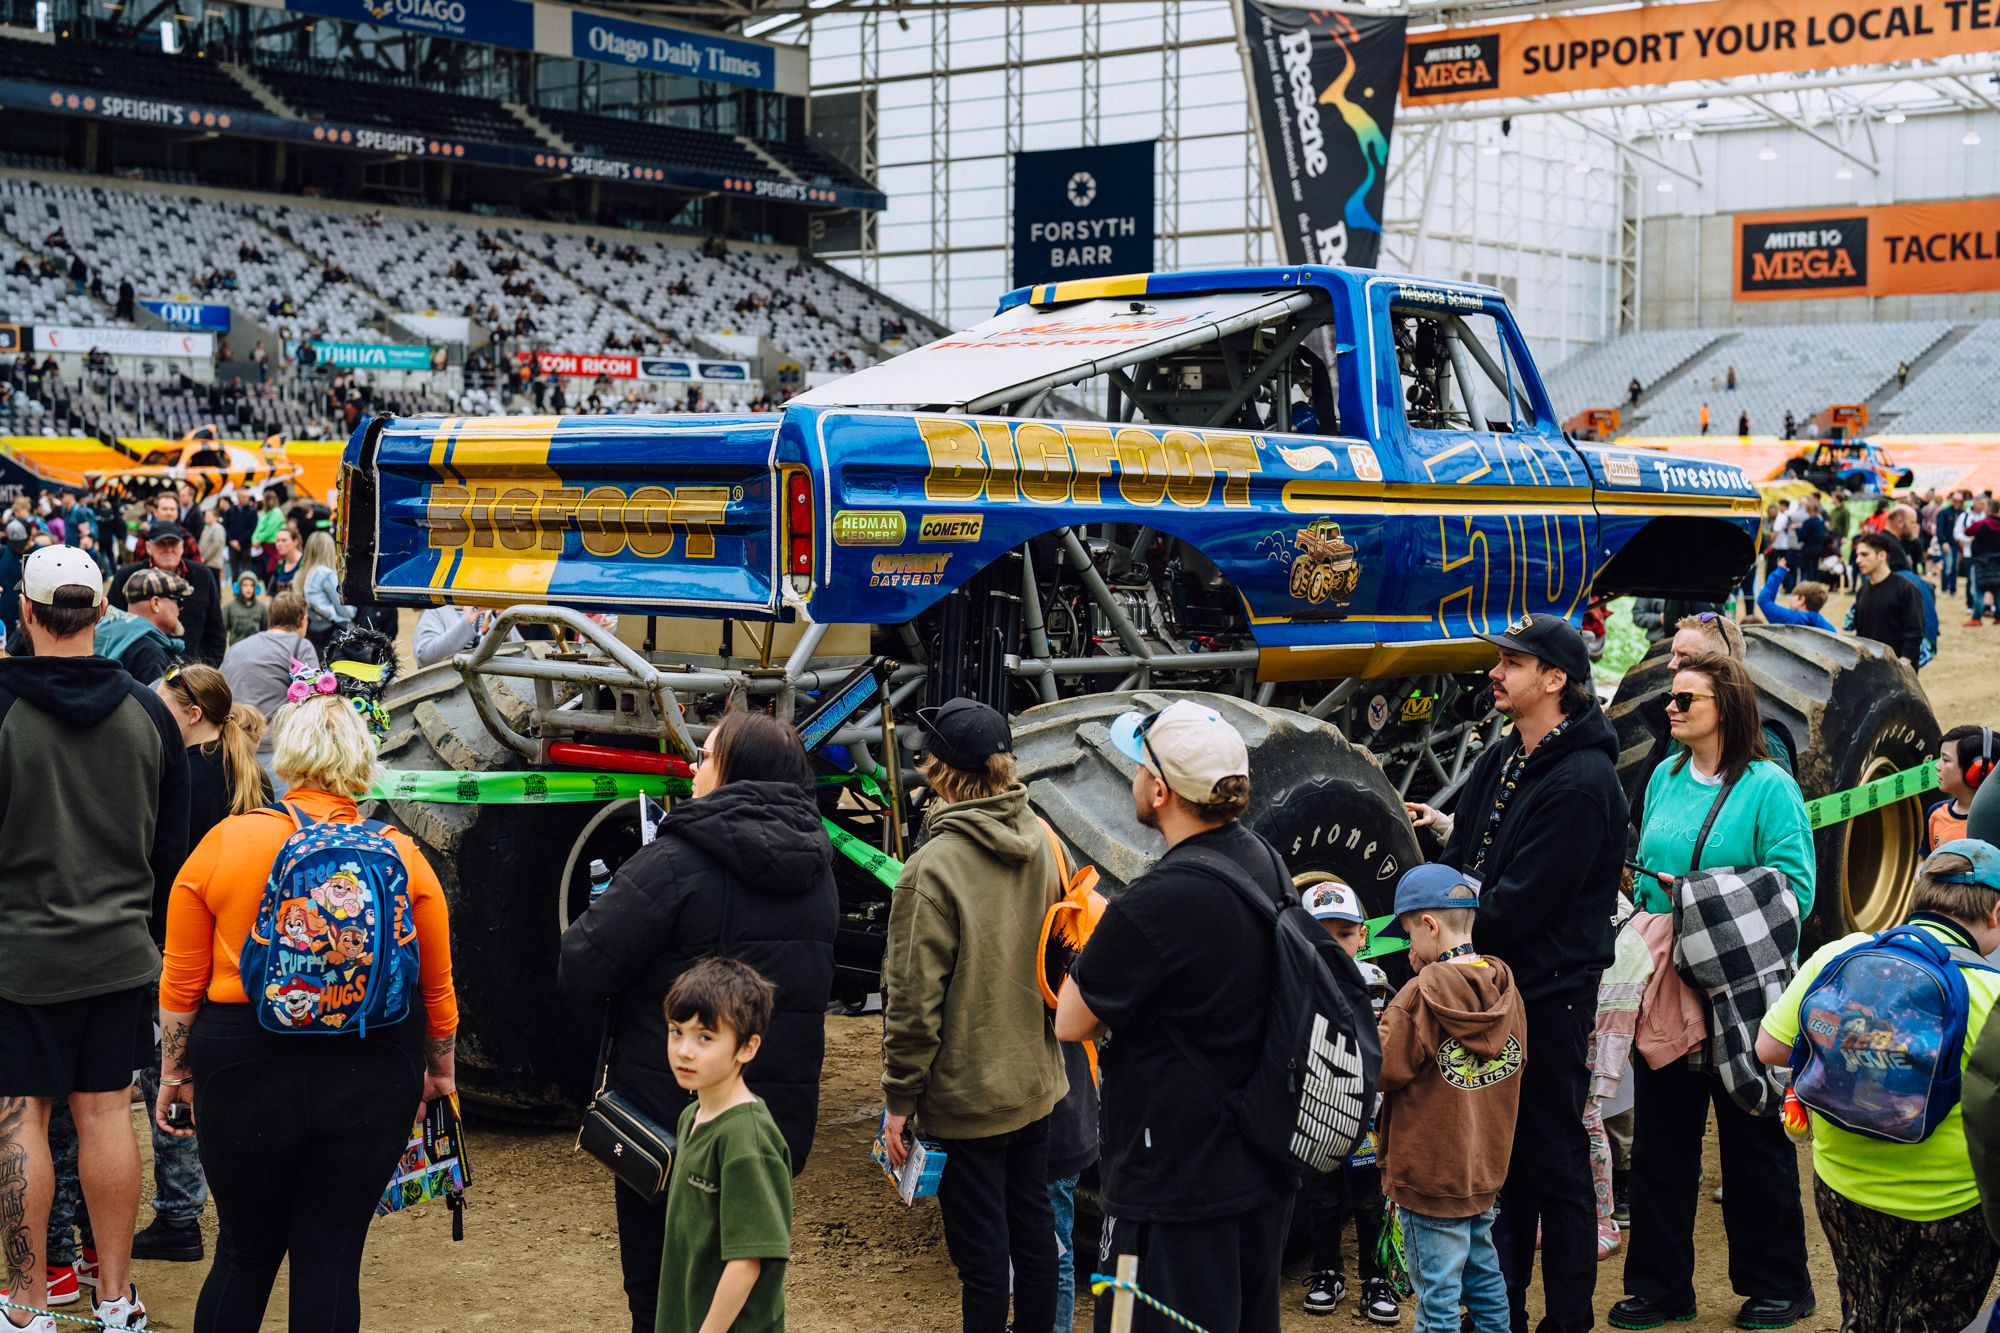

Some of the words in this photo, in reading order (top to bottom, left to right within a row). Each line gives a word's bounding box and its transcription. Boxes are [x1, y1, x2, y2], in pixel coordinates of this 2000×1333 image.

[397, 0, 465, 23] OTAGO
[1523, 31, 1684, 75] SUPPORT
[1694, 19, 1796, 57] YOUR
[1807, 4, 1933, 47] LOCAL
[588, 26, 648, 63] Otago
[652, 38, 702, 74] Daily
[705, 47, 761, 78] Times
[1424, 46, 1462, 63] MITRE
[1464, 44, 1481, 59] 10
[1272, 73, 1284, 95] the
[1414, 59, 1491, 88] MEGA
[101, 96, 184, 125] SPEIGHT'S
[1279, 28, 1328, 178] Resene
[356, 129, 426, 155] SPEIGHT'S
[571, 156, 630, 180] SPEIGHT'S
[755, 180, 807, 201] SPEIGHT'S
[1031, 217, 1136, 242] FORSYTH
[1764, 231, 1818, 249] MITRE
[1819, 229, 1842, 247] 10
[1051, 245, 1112, 267] BARR
[1883, 231, 2000, 264] TACKL
[1752, 248, 1856, 281] MEGA
[1398, 284, 1445, 304] Rebecca
[160, 303, 204, 324] ODT
[931, 337, 1149, 351] Firestone
[582, 357, 633, 375] RICOH
[914, 416, 1262, 508] BIGFOOT
[1352, 448, 1380, 477] PPG
[1654, 461, 1753, 493] Firestone
[427, 482, 731, 559] BIGFOOT
[842, 517, 898, 530] HEDMAN
[922, 521, 980, 537] COMETIC
[841, 531, 897, 541] HEDDERS
[869, 573, 945, 587] BATTERY
[279, 951, 328, 976] PUPPY
[318, 974, 367, 1014] HUGS
[1808, 1019, 1838, 1038] LEGO
[1508, 1052, 1521, 1062] 22
[1840, 1048, 1913, 1072] MOVIE
[1485, 1063, 1516, 1083] USA
[1290, 1013, 1364, 1173] NIKE
